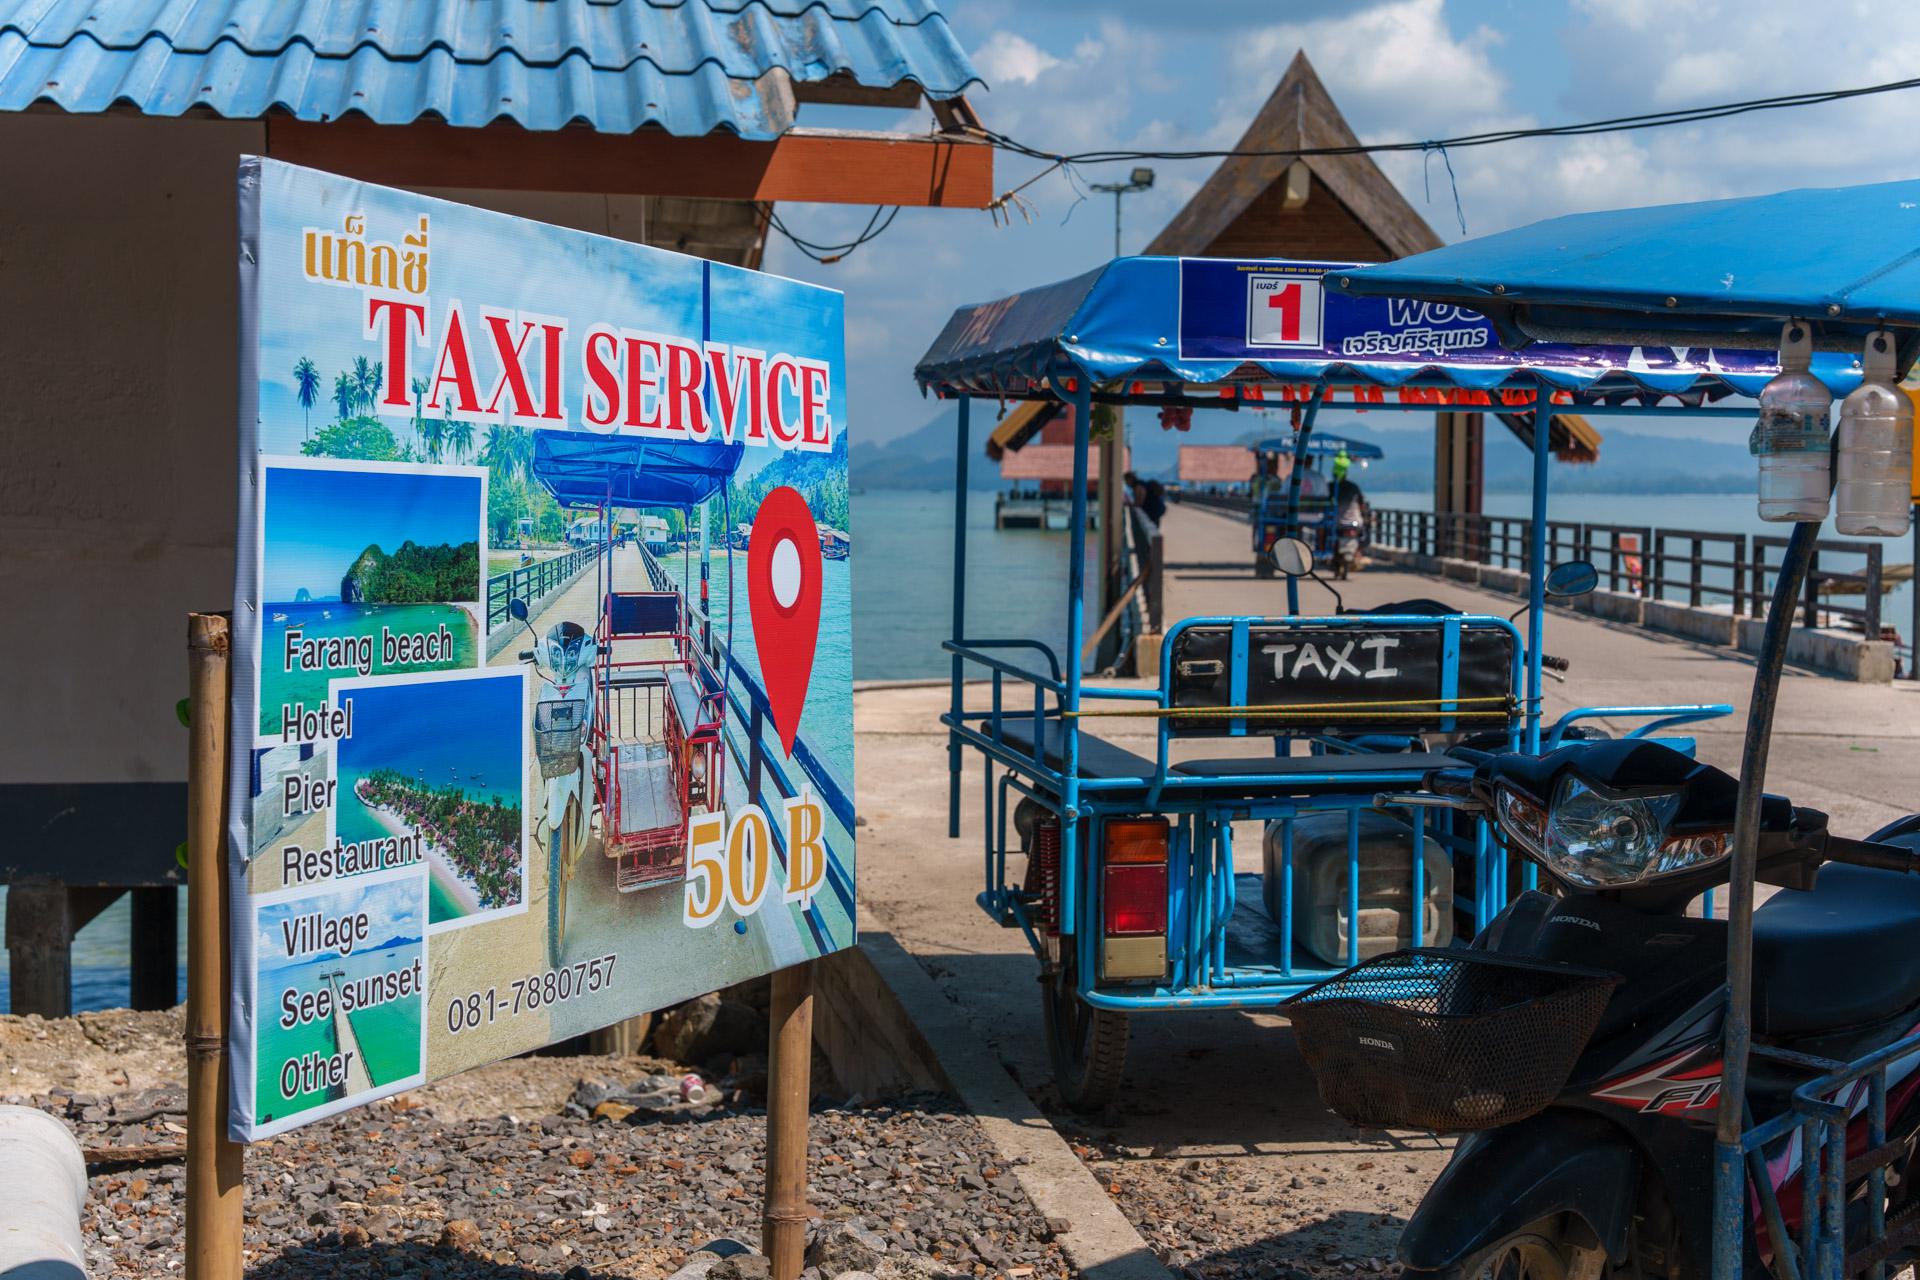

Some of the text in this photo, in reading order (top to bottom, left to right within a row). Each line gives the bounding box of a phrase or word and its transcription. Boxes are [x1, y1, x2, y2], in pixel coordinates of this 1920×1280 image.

[304, 214, 429, 294] แท็กซี่
[1268, 283, 1302, 341] 1
[369, 299, 831, 445] TAXI SERVICE
[285, 624, 452, 676] Farang beach
[1262, 638, 1399, 680] TAXI
[283, 700, 352, 743] Hotel
[284, 775, 336, 814] Pier
[283, 825, 422, 885] Restaurant
[688, 813, 768, 919] 50
[283, 913, 369, 957] Village
[1550, 915, 1601, 931] HONDA
[281, 958, 422, 1027] See sunset
[448, 955, 617, 1032] 081-7880757
[1359, 1036, 1395, 1050] HONDA
[281, 1051, 353, 1098] Other
